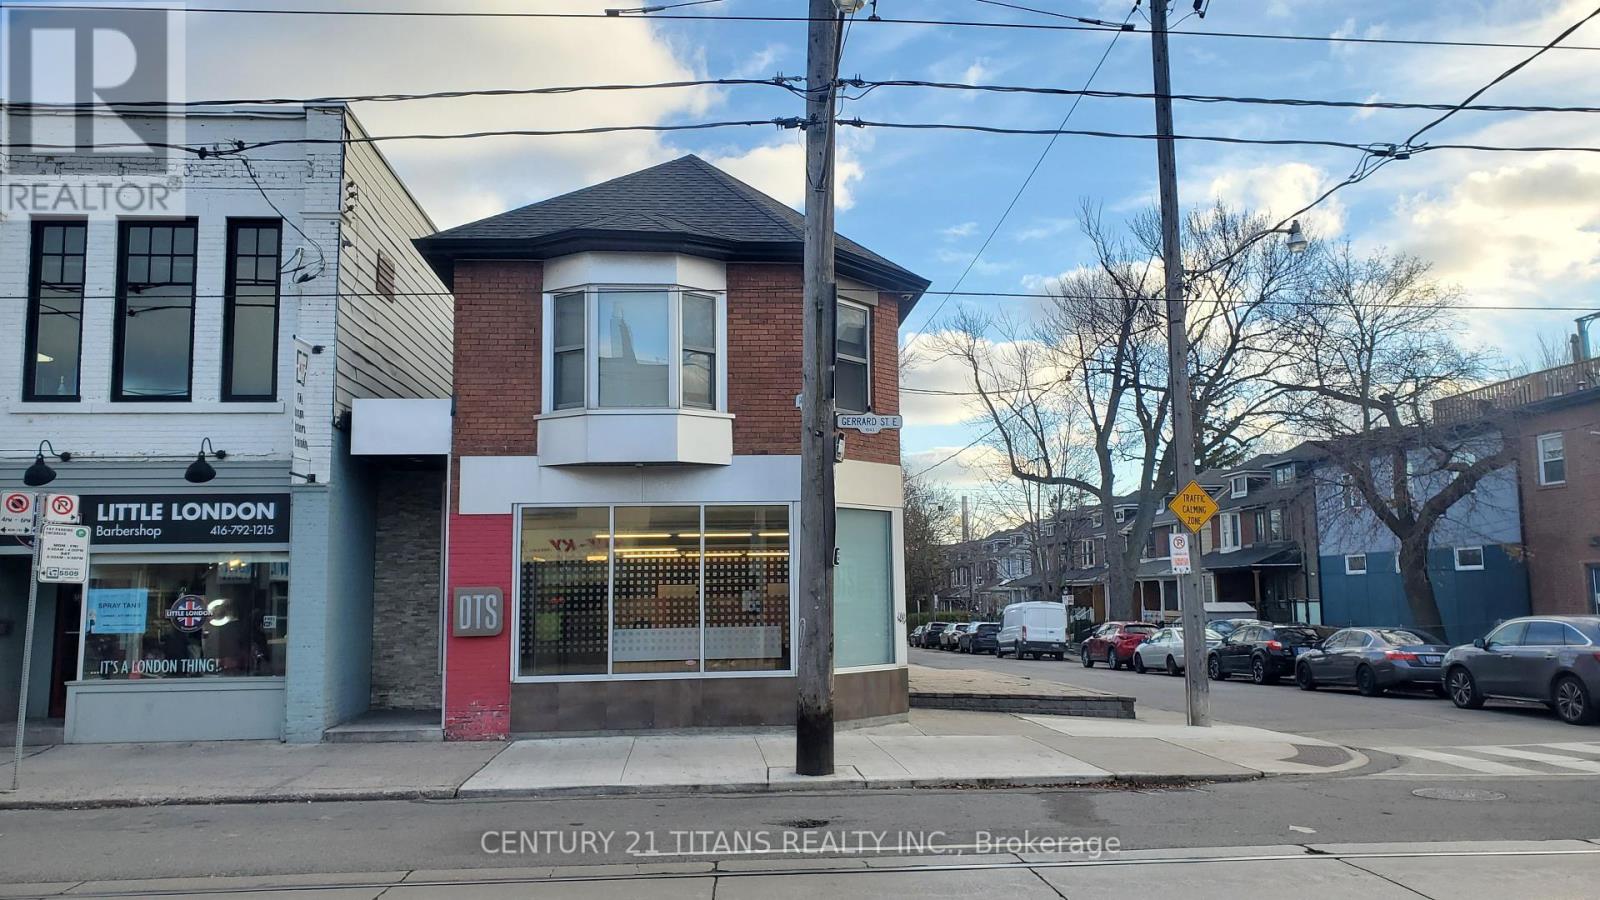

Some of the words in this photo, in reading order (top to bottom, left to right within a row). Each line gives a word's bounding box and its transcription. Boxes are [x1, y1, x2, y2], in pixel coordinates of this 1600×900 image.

[841, 417, 877, 427] GERRARD
[1182, 494, 1206, 503] TRAFFIC
[97, 503, 163, 521] LITTLE
[171, 502, 275, 521] LONDON
[1182, 505, 1207, 514] CALMING
[1187, 517, 1201, 525] ZONE
[96, 524, 162, 539] Barbershop
[209, 525, 274, 536] 416-792-1215
[459, 594, 498, 630] DTS
[121, 661, 129, 674] A
[131, 659, 177, 674] LONDON
[180, 658, 219, 673] THING!
